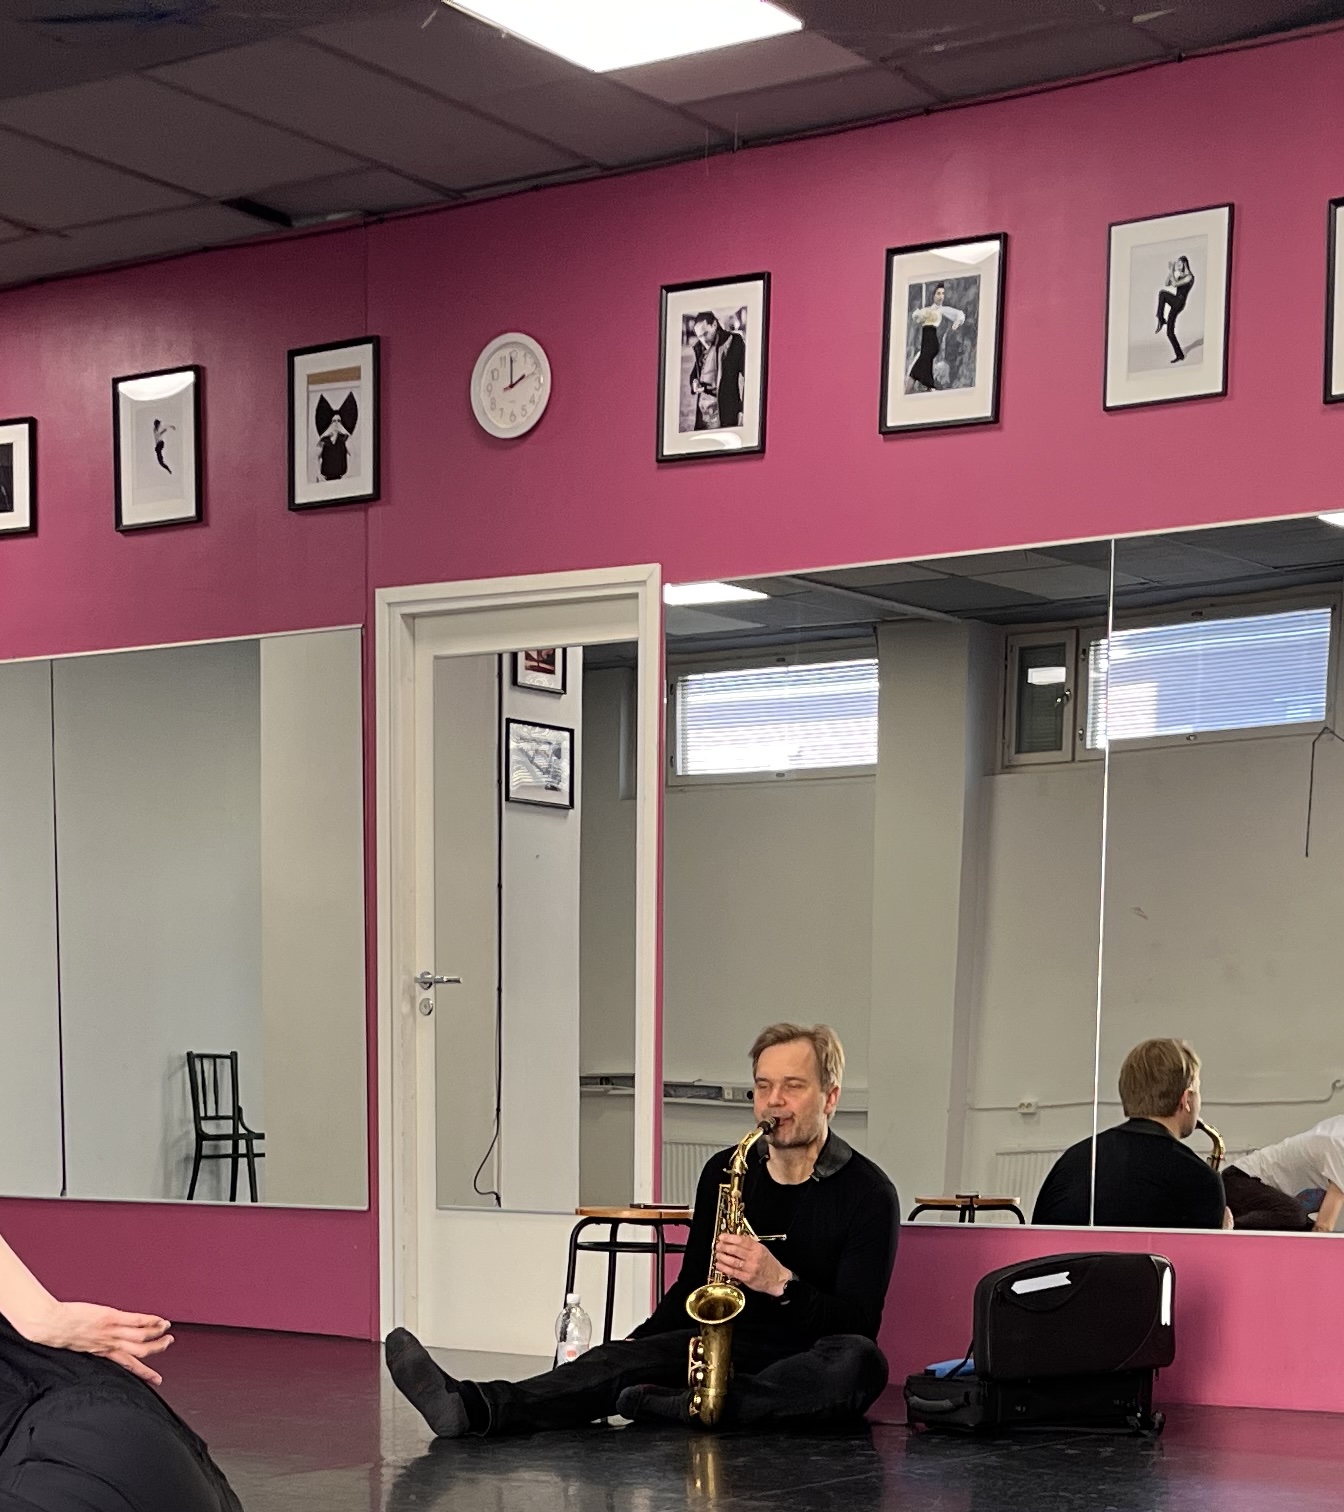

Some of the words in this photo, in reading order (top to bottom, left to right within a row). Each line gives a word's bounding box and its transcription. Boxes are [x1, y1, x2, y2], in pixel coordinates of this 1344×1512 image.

[500, 355, 506, 369] 11
[486, 383, 493, 397] 9
[489, 397, 497, 411] 8
[529, 393, 536, 405] 4
[499, 407, 505, 420] 7
[510, 410, 517, 422] 6
[520, 404, 528, 418] 5
